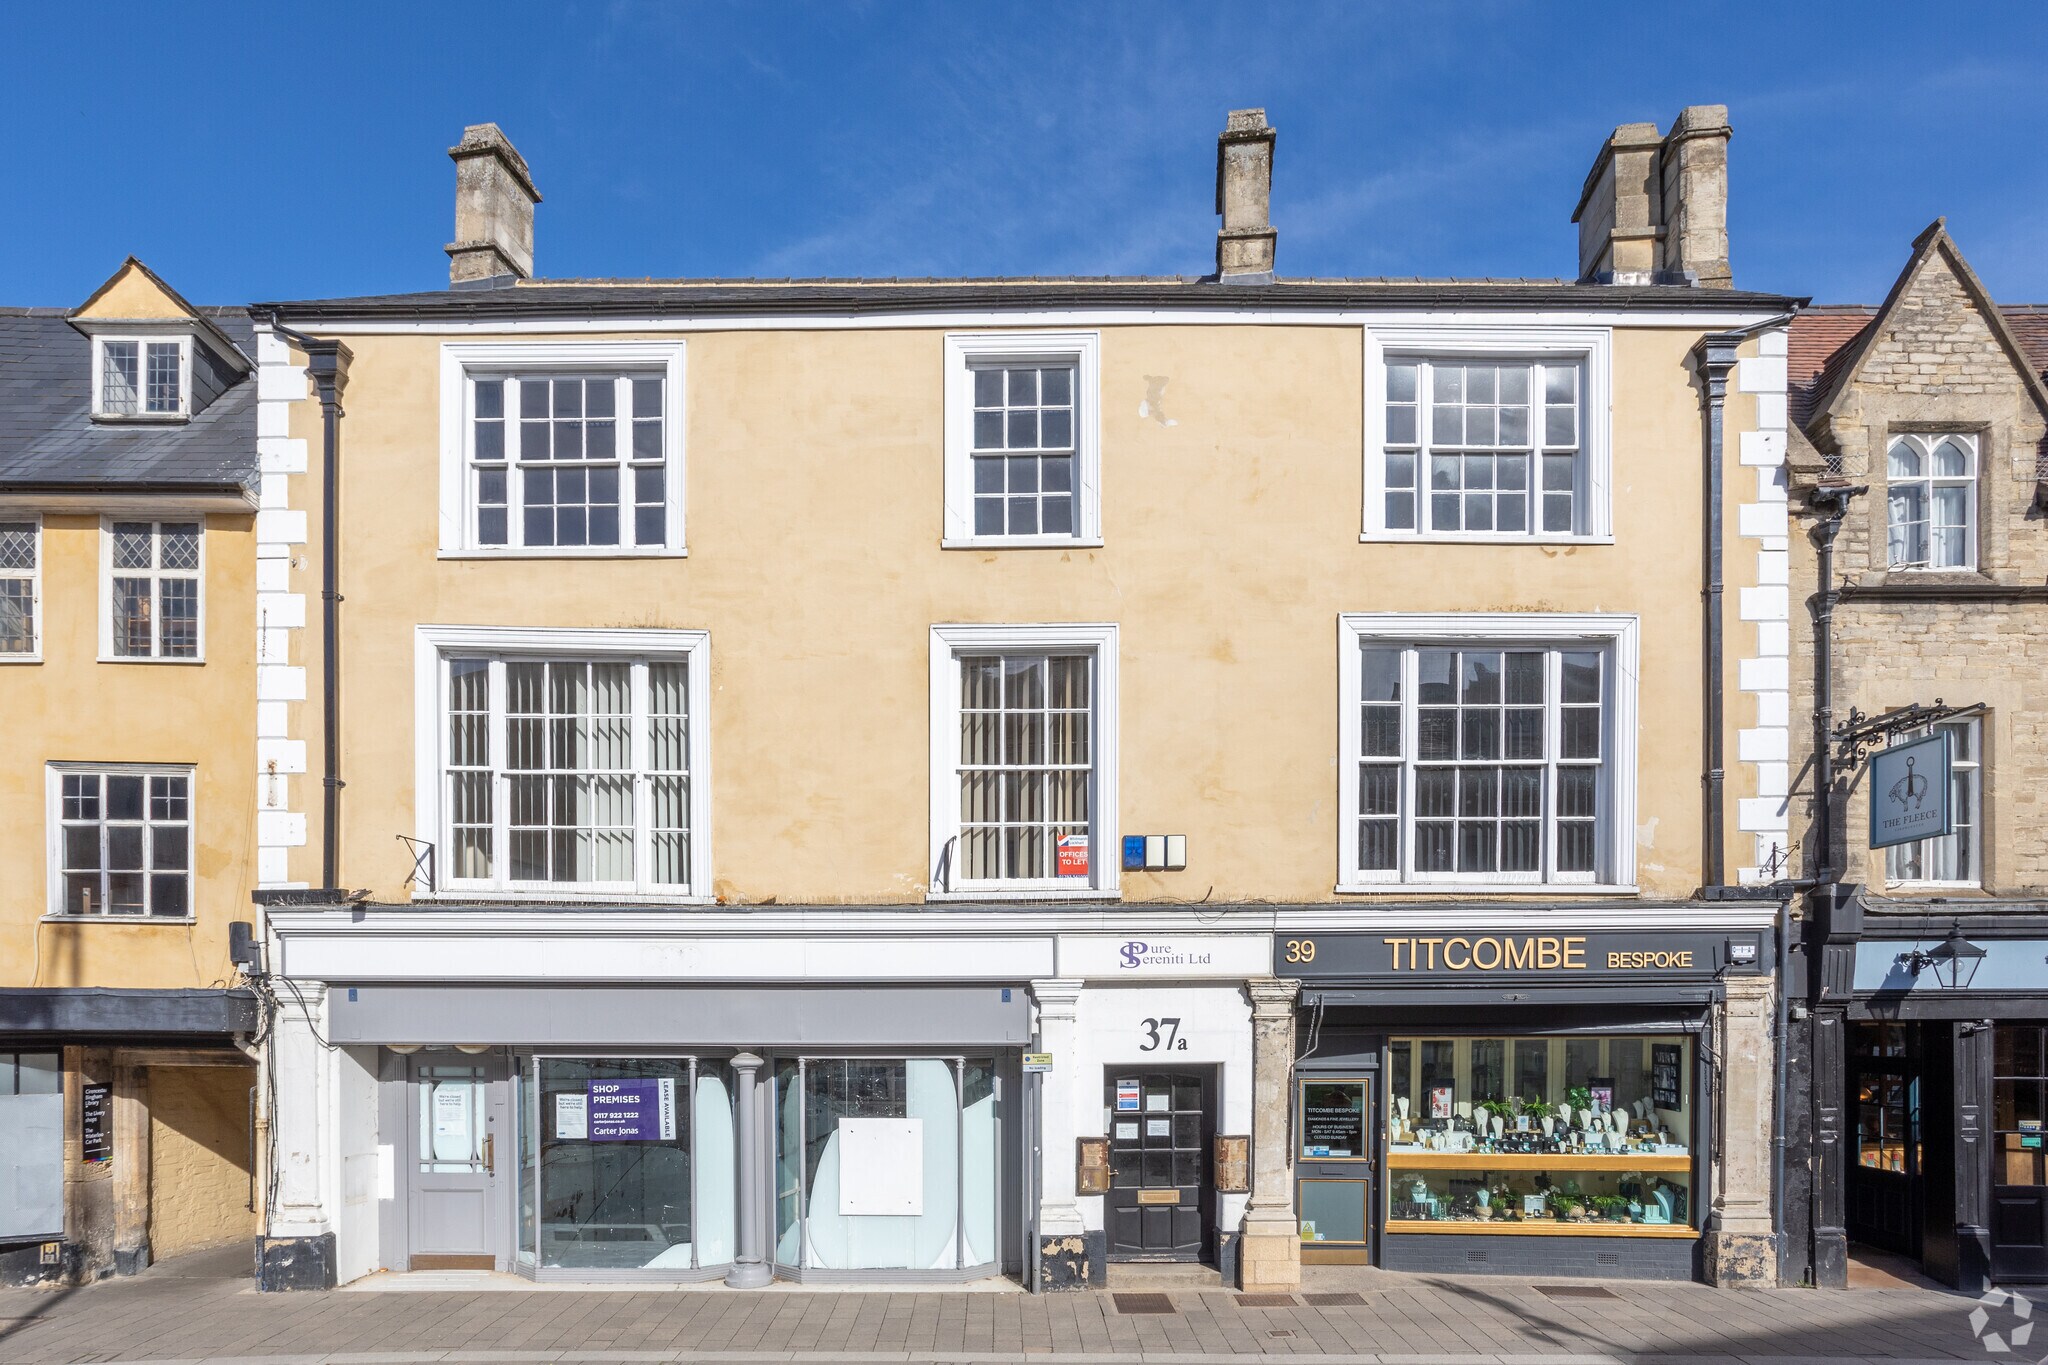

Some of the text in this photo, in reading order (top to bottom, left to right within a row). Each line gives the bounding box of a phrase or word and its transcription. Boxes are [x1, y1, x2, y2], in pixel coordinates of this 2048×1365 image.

[1883, 809, 1937, 828] THE FLEECE
[1189, 953, 1211, 964] Ltd
[1285, 937, 1693, 970] 39 TITCOMBE BESPOKE
[1140, 1018, 1188, 1051] 37a
[593, 1085, 619, 1093] SHOP
[593, 1095, 640, 1104] PREMISES
[593, 1127, 639, 1136] Carter Jonas
